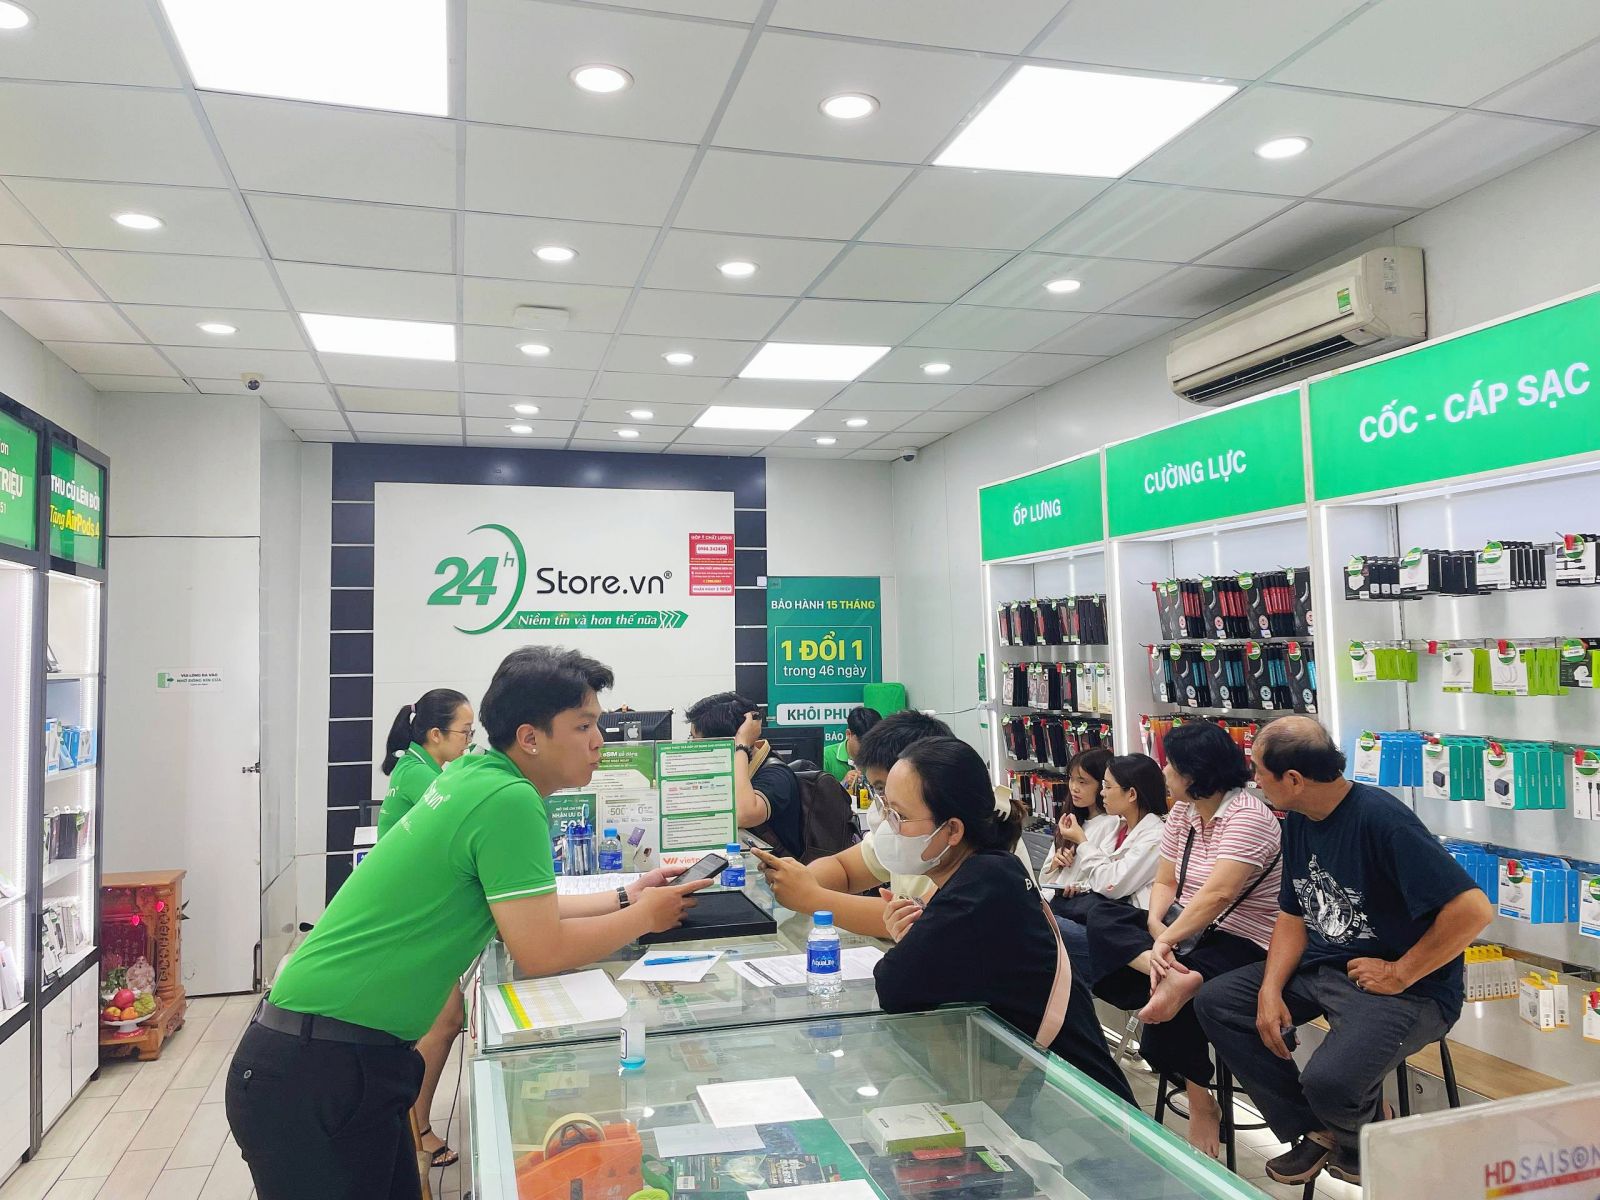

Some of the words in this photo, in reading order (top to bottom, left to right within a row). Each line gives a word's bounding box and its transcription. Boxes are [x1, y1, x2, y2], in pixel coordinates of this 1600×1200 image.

[1359, 399, 1418, 443] CỐC
[1443, 379, 1508, 423] CÁP
[1517, 362, 1590, 408] SẠC
[1144, 460, 1204, 494] CƯỜNG
[1208, 450, 1247, 484] LỰC
[51, 474, 65, 495] THU
[66, 480, 76, 500] CŨ
[50, 504, 65, 530] Tặng
[66, 509, 95, 537] AirPods
[1013, 502, 1028, 526] ỐP
[1030, 498, 1061, 520] LƯNG
[771, 598, 792, 609] BẢO
[795, 599, 824, 609] HÀNH
[826, 600, 837, 609] 15
[839, 598, 875, 609] THÁNG
[519, 612, 550, 626] Niềm
[554, 614, 570, 625] tin
[574, 614, 587, 625] và
[590, 614, 612, 625] hơn
[616, 612, 635, 625] thế
[637, 614, 657, 625] nữa
[781, 640, 792, 661] 1
[799, 631, 845, 661] ĐỔI
[852, 640, 863, 661] 1
[783, 665, 816, 679] trong
[819, 665, 834, 676] 46
[837, 664, 867, 678] ngày
[787, 706, 821, 720] KHÔI
[825, 731, 843, 741] BẢO
[1485, 1159, 1515, 1187] HD
